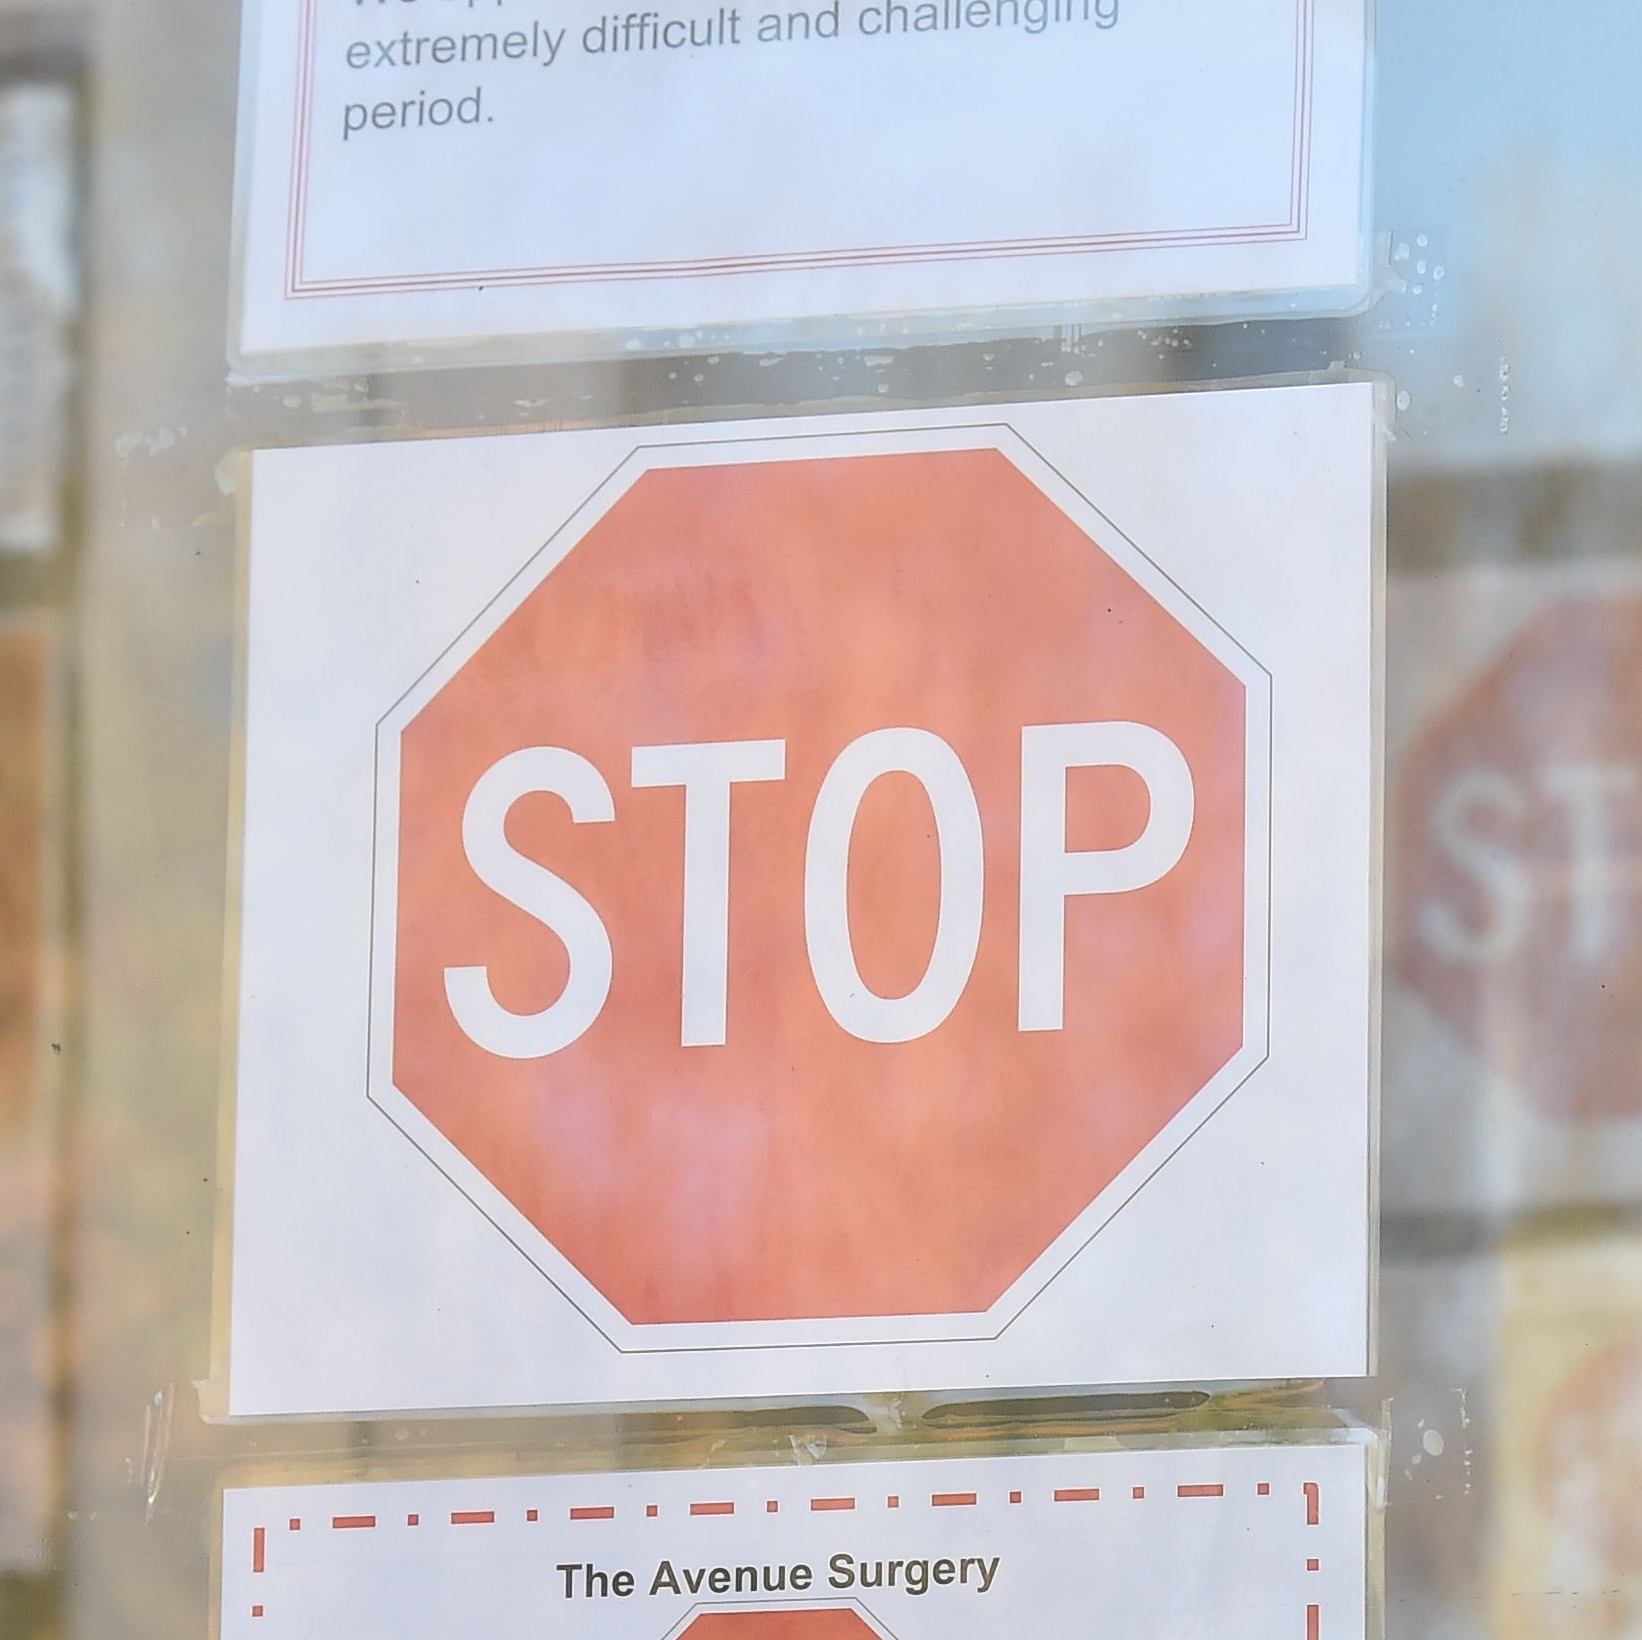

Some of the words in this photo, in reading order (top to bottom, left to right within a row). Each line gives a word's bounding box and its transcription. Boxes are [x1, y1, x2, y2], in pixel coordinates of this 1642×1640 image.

[344, 20, 568, 72] extremely
[581, 6, 743, 56] difficult
[756, 0, 841, 44] and
[857, 0, 1120, 36] challenging
[342, 87, 495, 142] period.
[444, 720, 1195, 1058] STOP
[557, 1562, 635, 1598] The
[648, 1558, 813, 1596] Avenue
[827, 1553, 1001, 1594] Surgery
